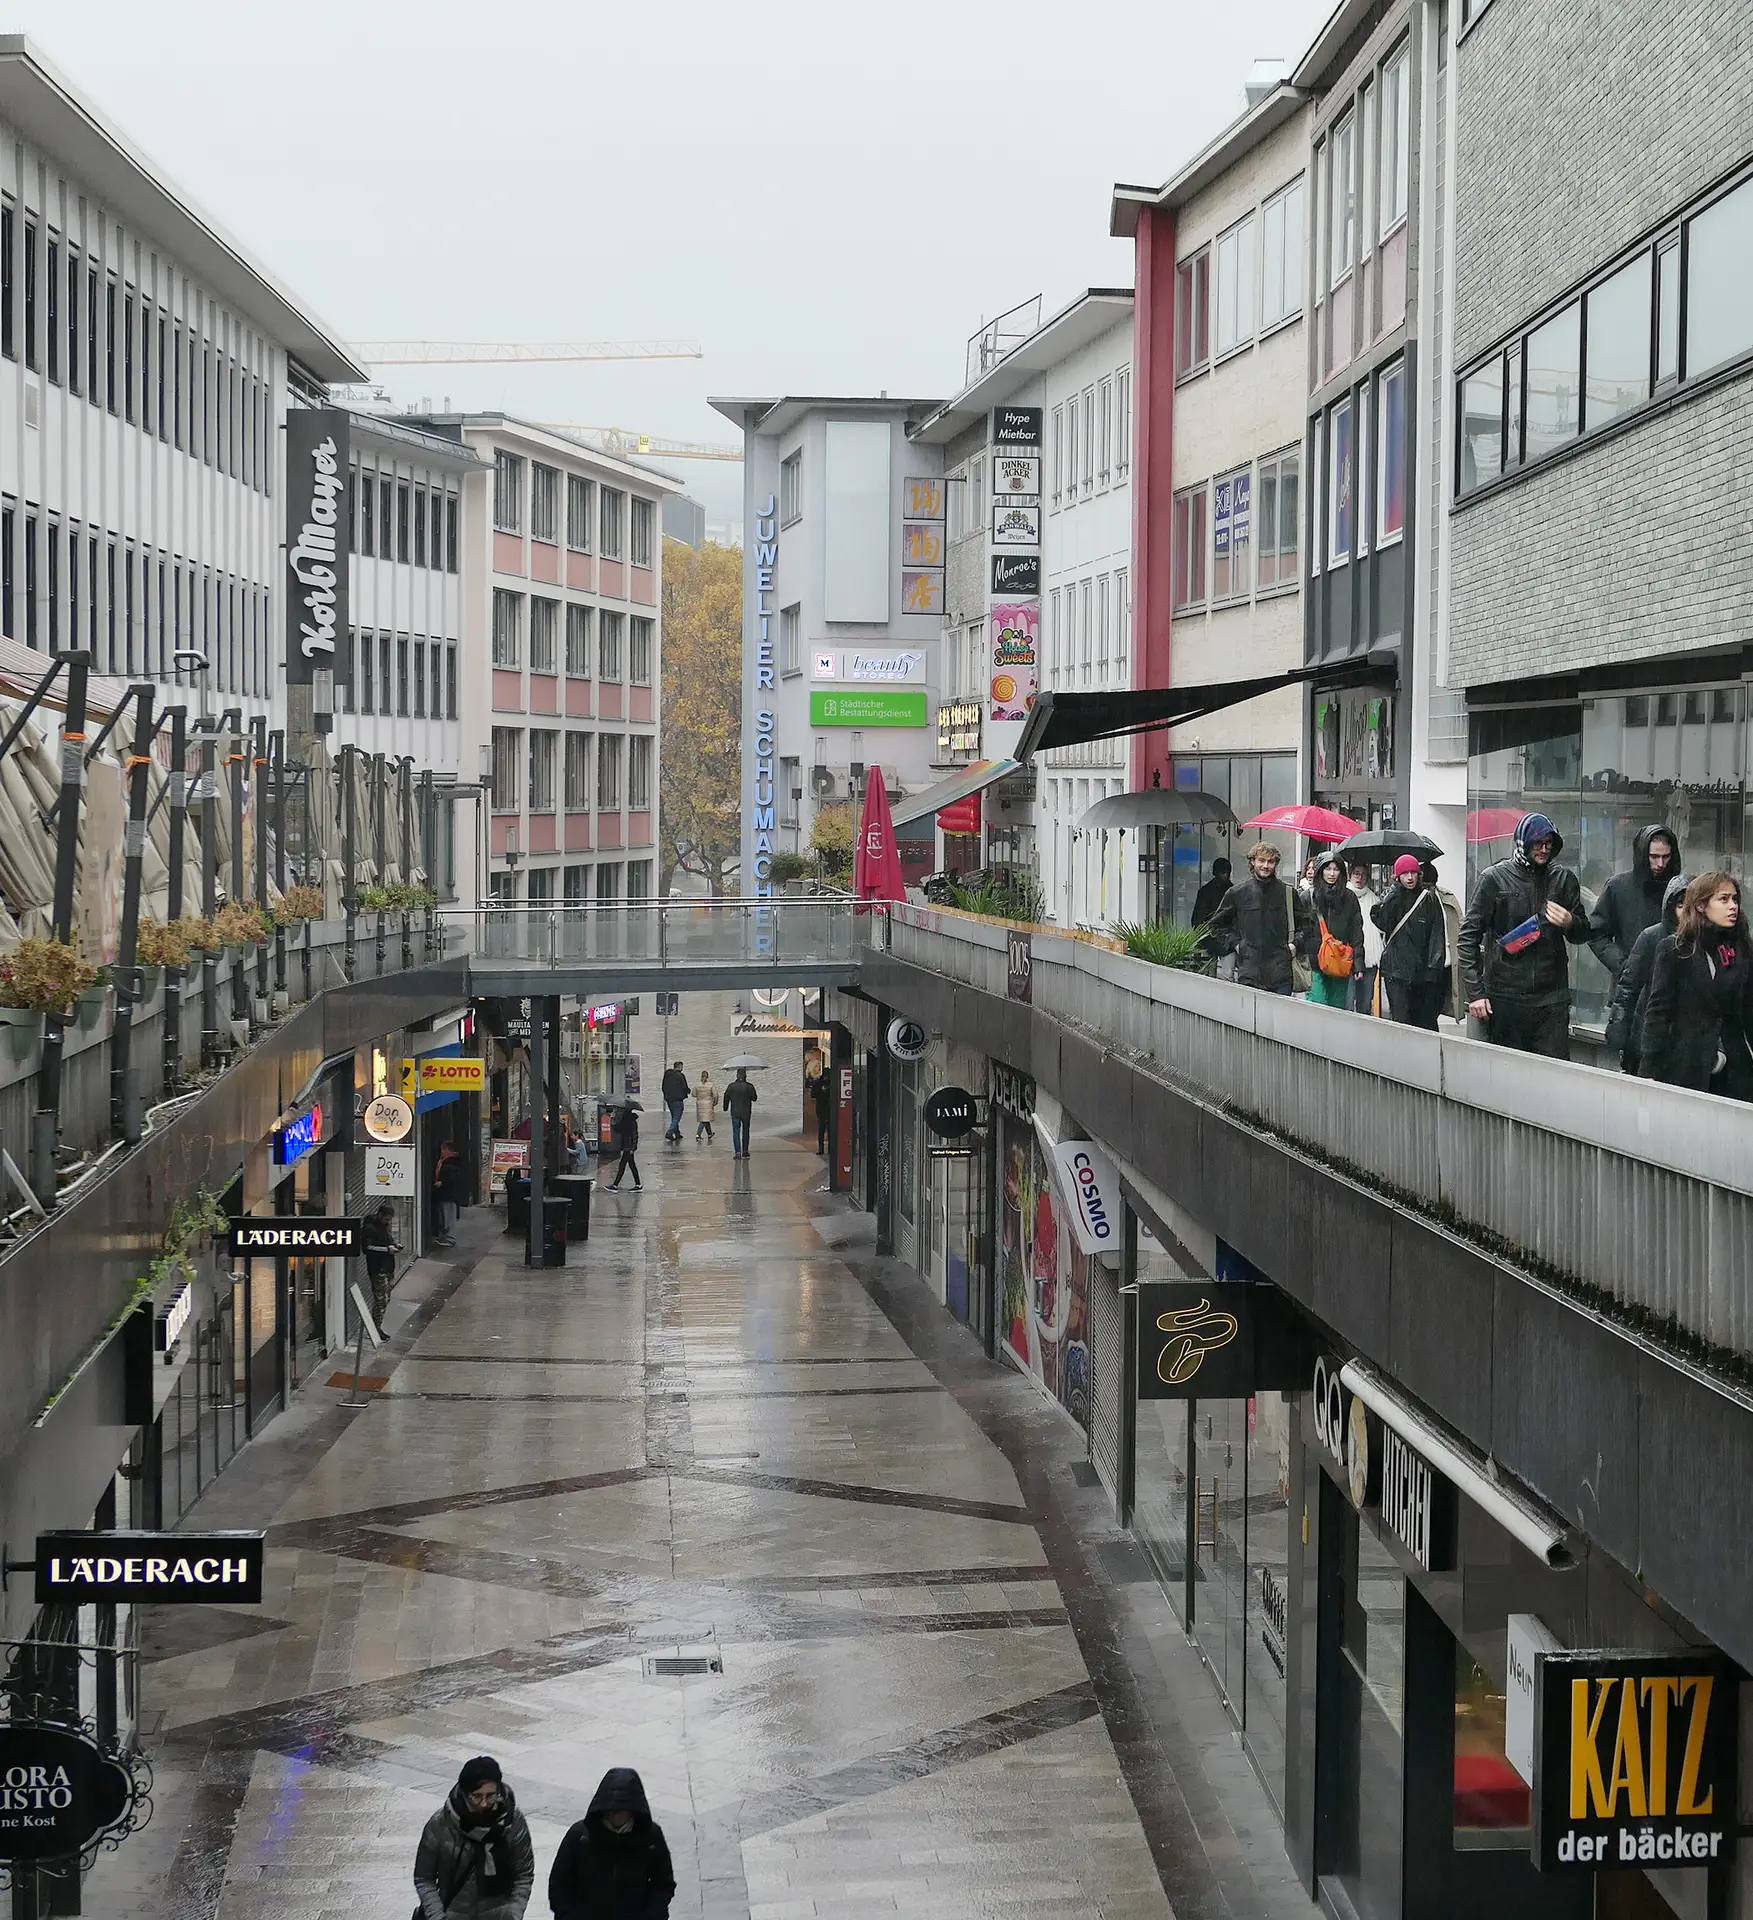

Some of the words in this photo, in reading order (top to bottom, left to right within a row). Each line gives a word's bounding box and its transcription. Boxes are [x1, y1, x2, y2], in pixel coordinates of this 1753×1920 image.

[1004, 412, 1031, 426] Hype
[998, 428, 1037, 440] Mietbar
[1001, 460, 1032, 472] DINKEL
[1003, 468, 1031, 480] ACKER
[994, 557, 1037, 589] Monroe's
[753, 494, 778, 692] JUWELIER
[820, 659, 829, 667] M
[995, 648, 1034, 665] Sweets
[853, 671, 895, 679] STORE
[840, 699, 885, 708] Städtischer
[840, 708, 912, 719] Bestattungsdienst
[439, 1066, 481, 1078] LOTTO
[374, 1103, 399, 1116] Don
[388, 1116, 403, 1127] Ya
[376, 1156, 401, 1170] Don
[390, 1169, 404, 1179] Ya
[1073, 1152, 1111, 1239] COSMO
[236, 1229, 353, 1246] LÄDERACH
[1382, 1423, 1432, 1572] KITCHEN
[50, 1556, 248, 1584] LÄDERACH
[1569, 1675, 1715, 1820] KATZ
[23, 1814, 56, 1827] Kost
[1557, 1829, 1609, 1862] der
[1618, 1825, 1723, 1861] bäcker
